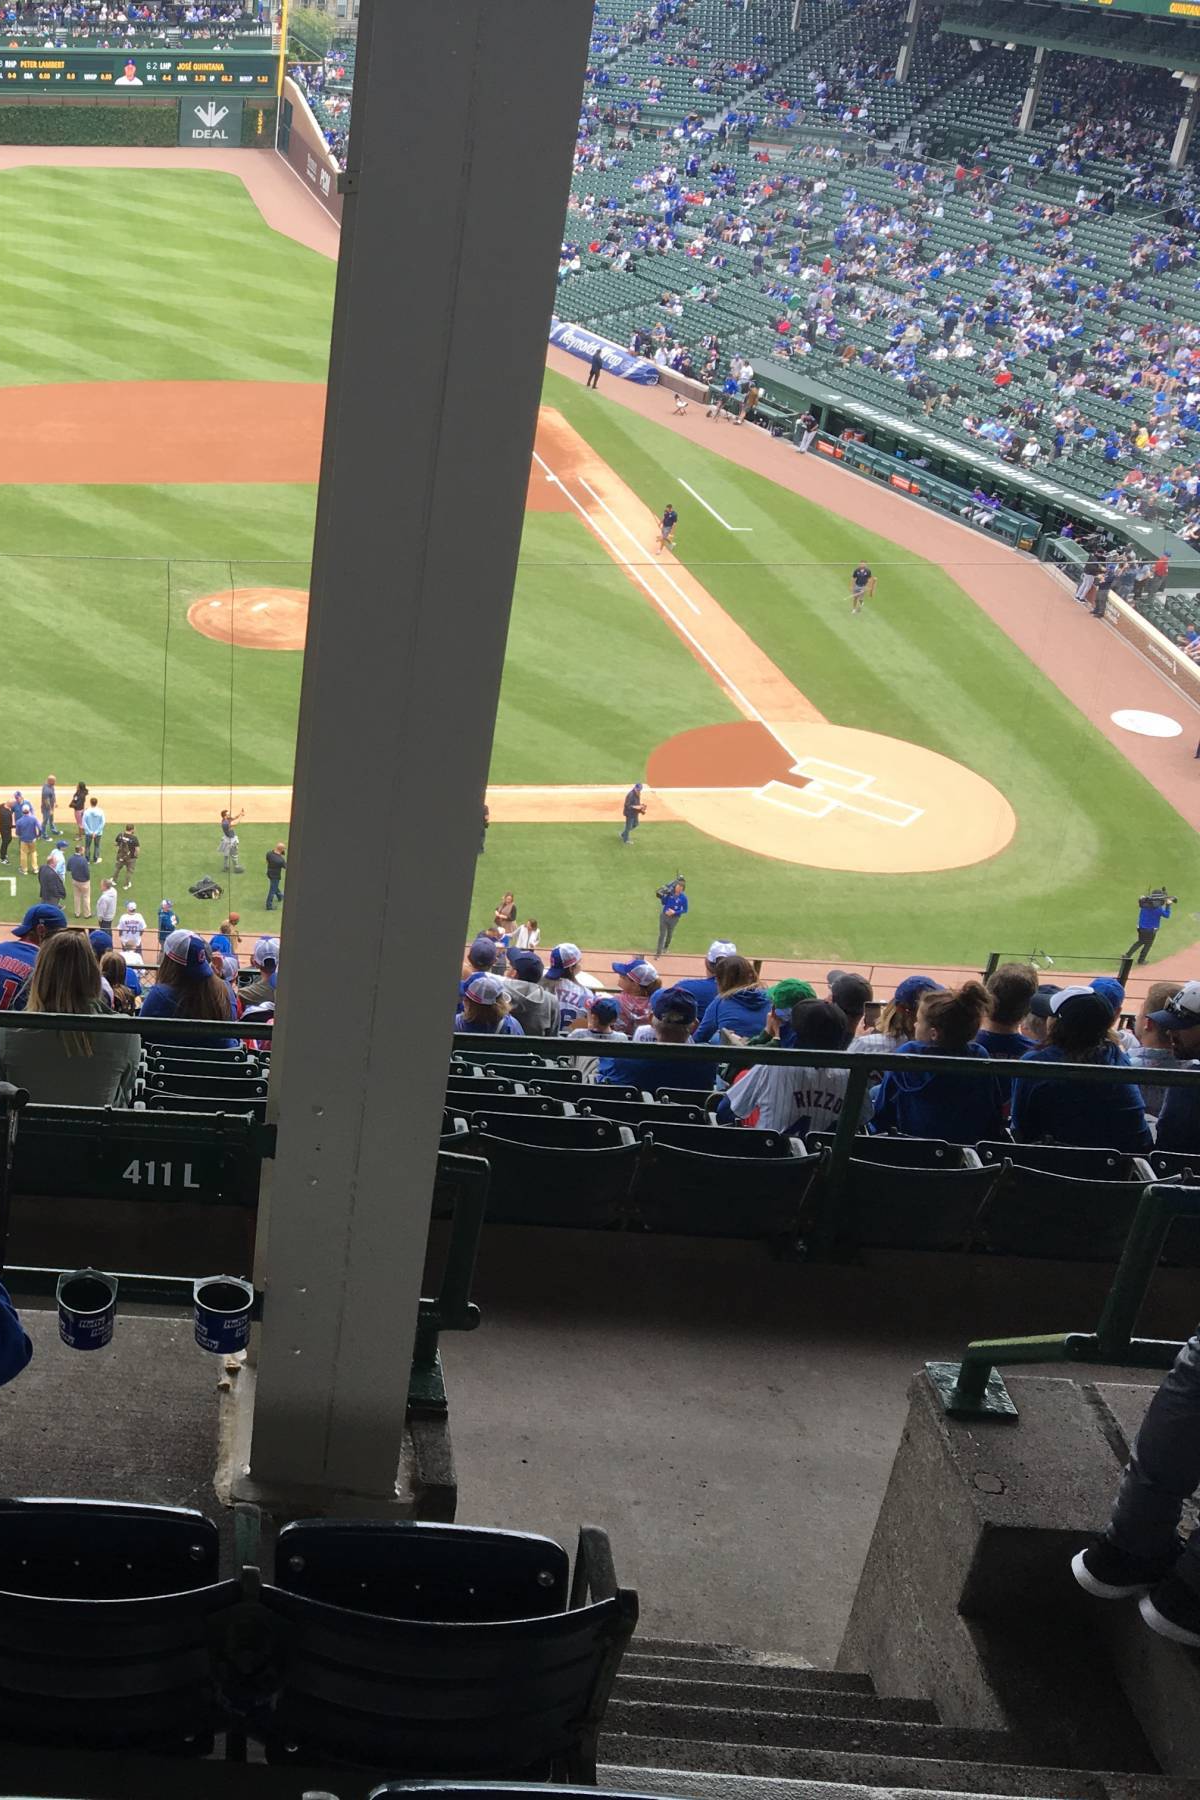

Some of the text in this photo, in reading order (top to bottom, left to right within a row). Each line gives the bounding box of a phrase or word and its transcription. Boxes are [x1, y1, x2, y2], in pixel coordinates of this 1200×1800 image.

[20, 60, 37, 69] PETER
[38, 60, 65, 69] LAMBERT
[176, 62, 192, 71] JOSÉ
[193, 62, 225, 71] QUINTANA
[192, 129, 229, 140] IDEAL
[559, 331, 624, 369] Reynolds Wrap
[793, 1090, 843, 1115] RIZZO
[122, 1159, 200, 1188] 411 L
